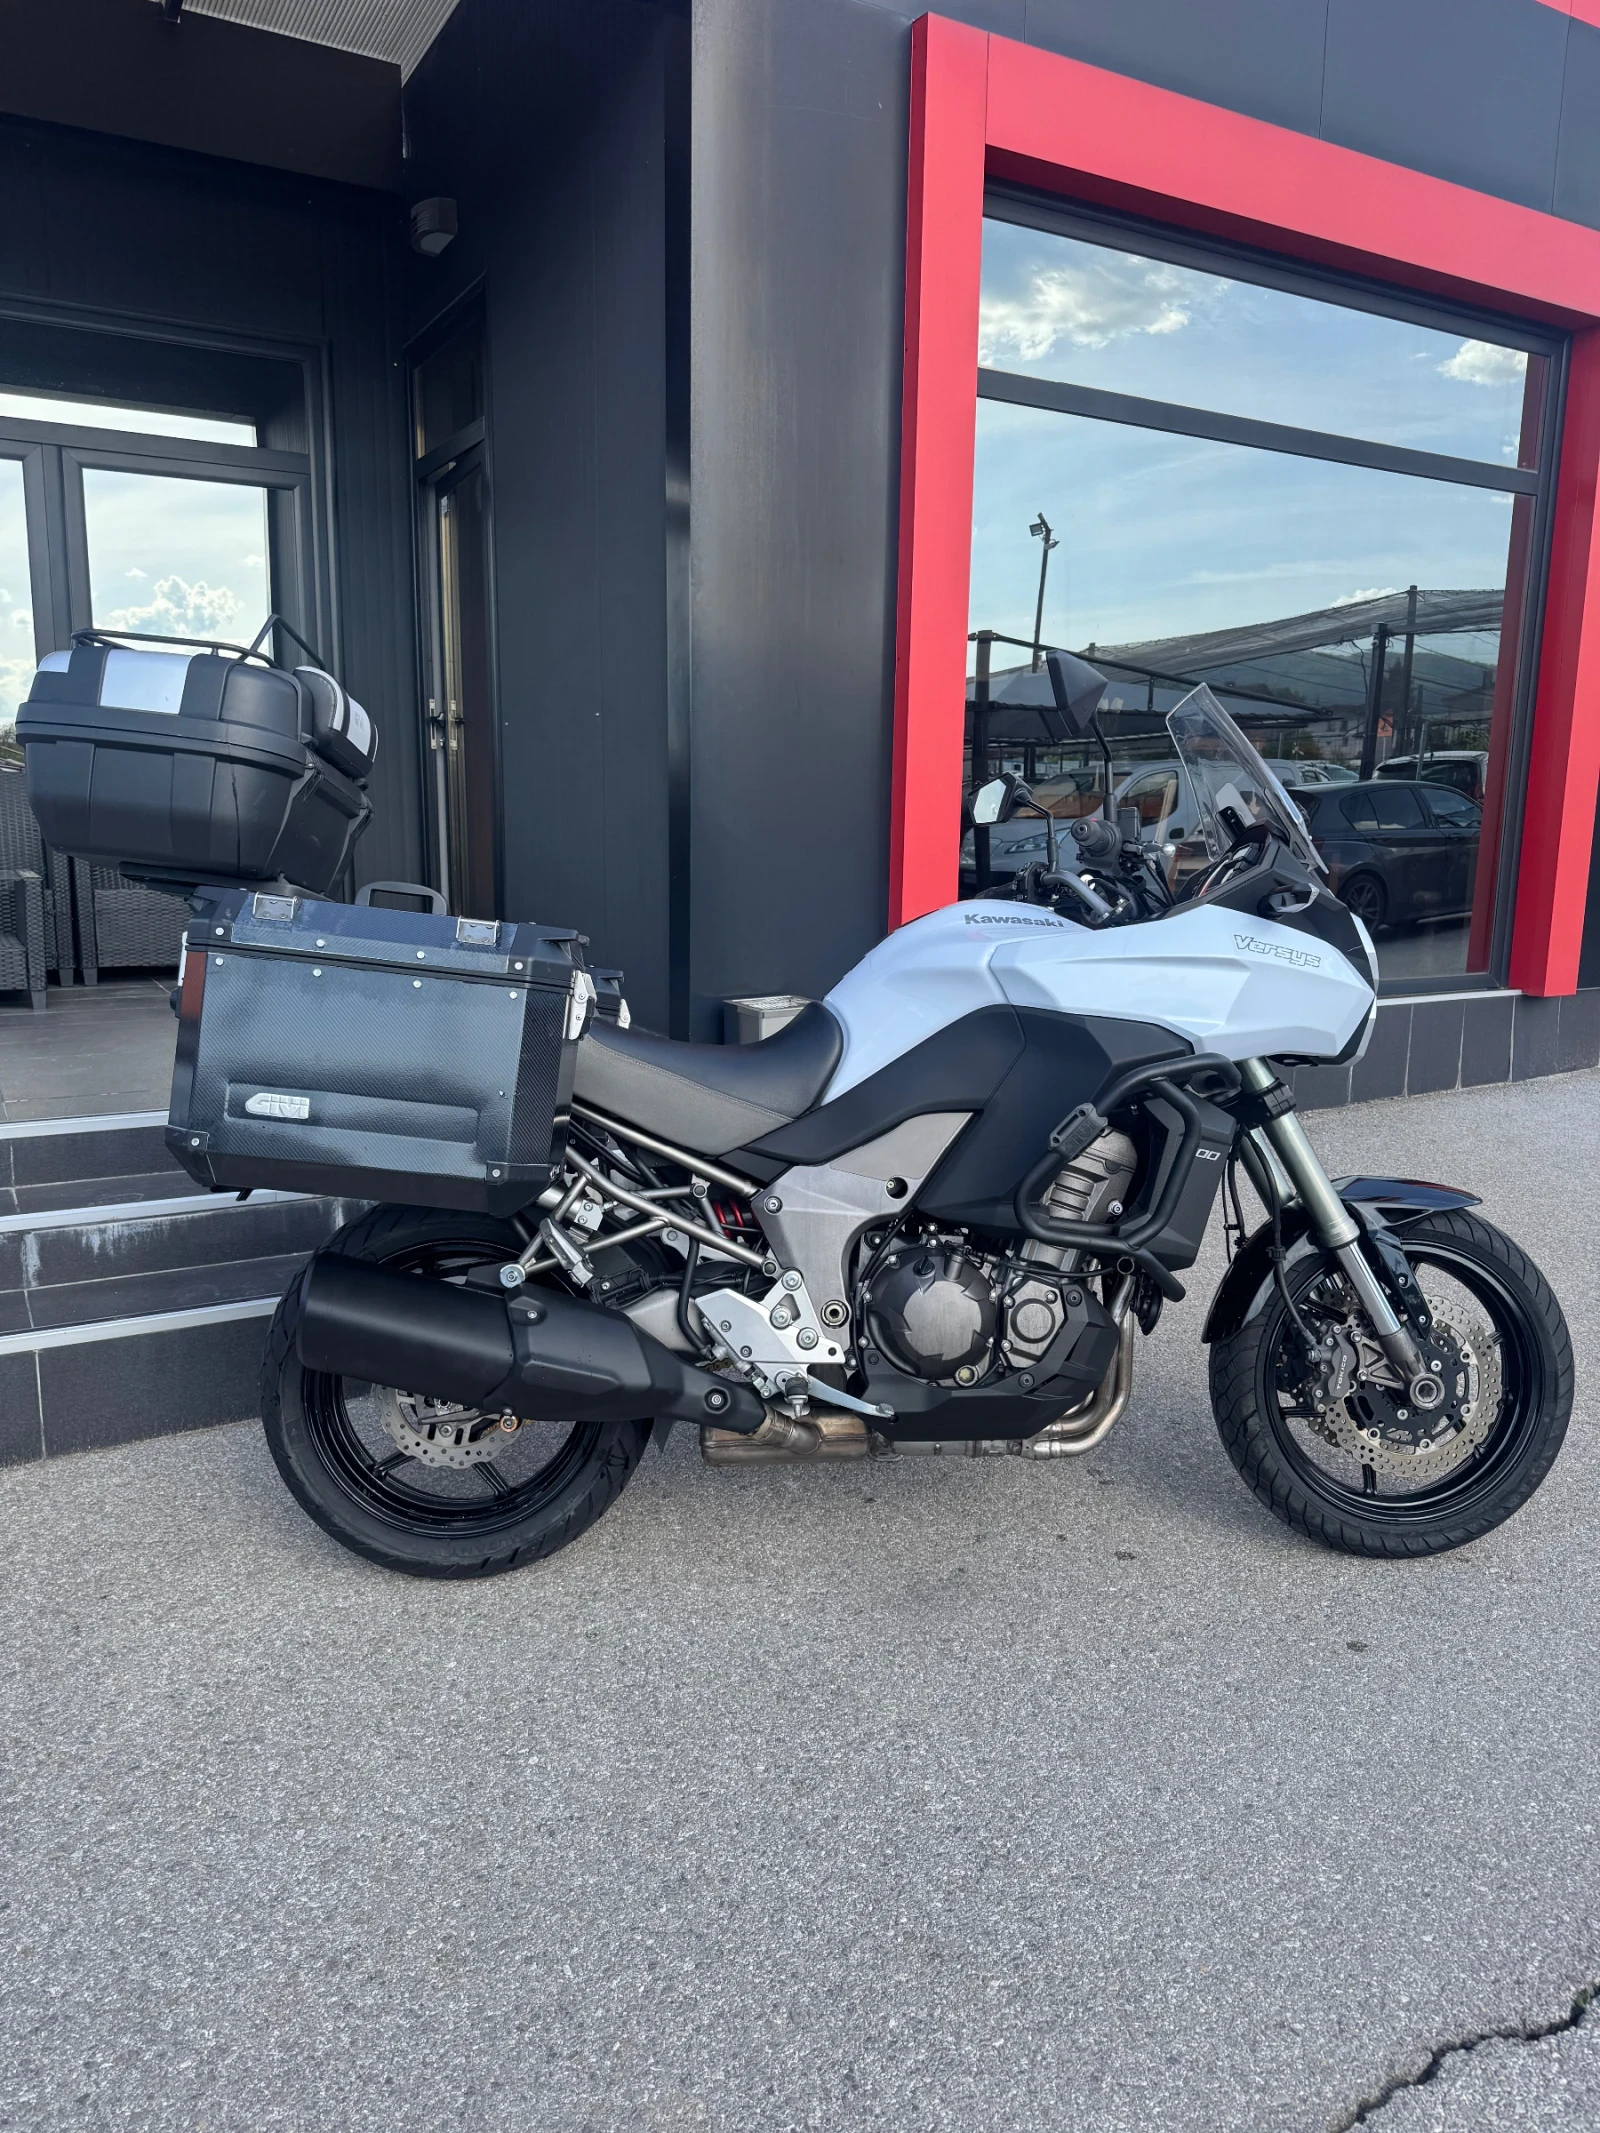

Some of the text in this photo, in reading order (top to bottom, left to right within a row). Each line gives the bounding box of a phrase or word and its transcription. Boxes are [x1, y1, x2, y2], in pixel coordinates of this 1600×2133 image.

[964, 913, 1064, 927] Kawasaki
[1233, 934, 1321, 968] Versys
[245, 1093, 309, 1119] GIVI
[1336, 1354, 1348, 1391] TOKICO
